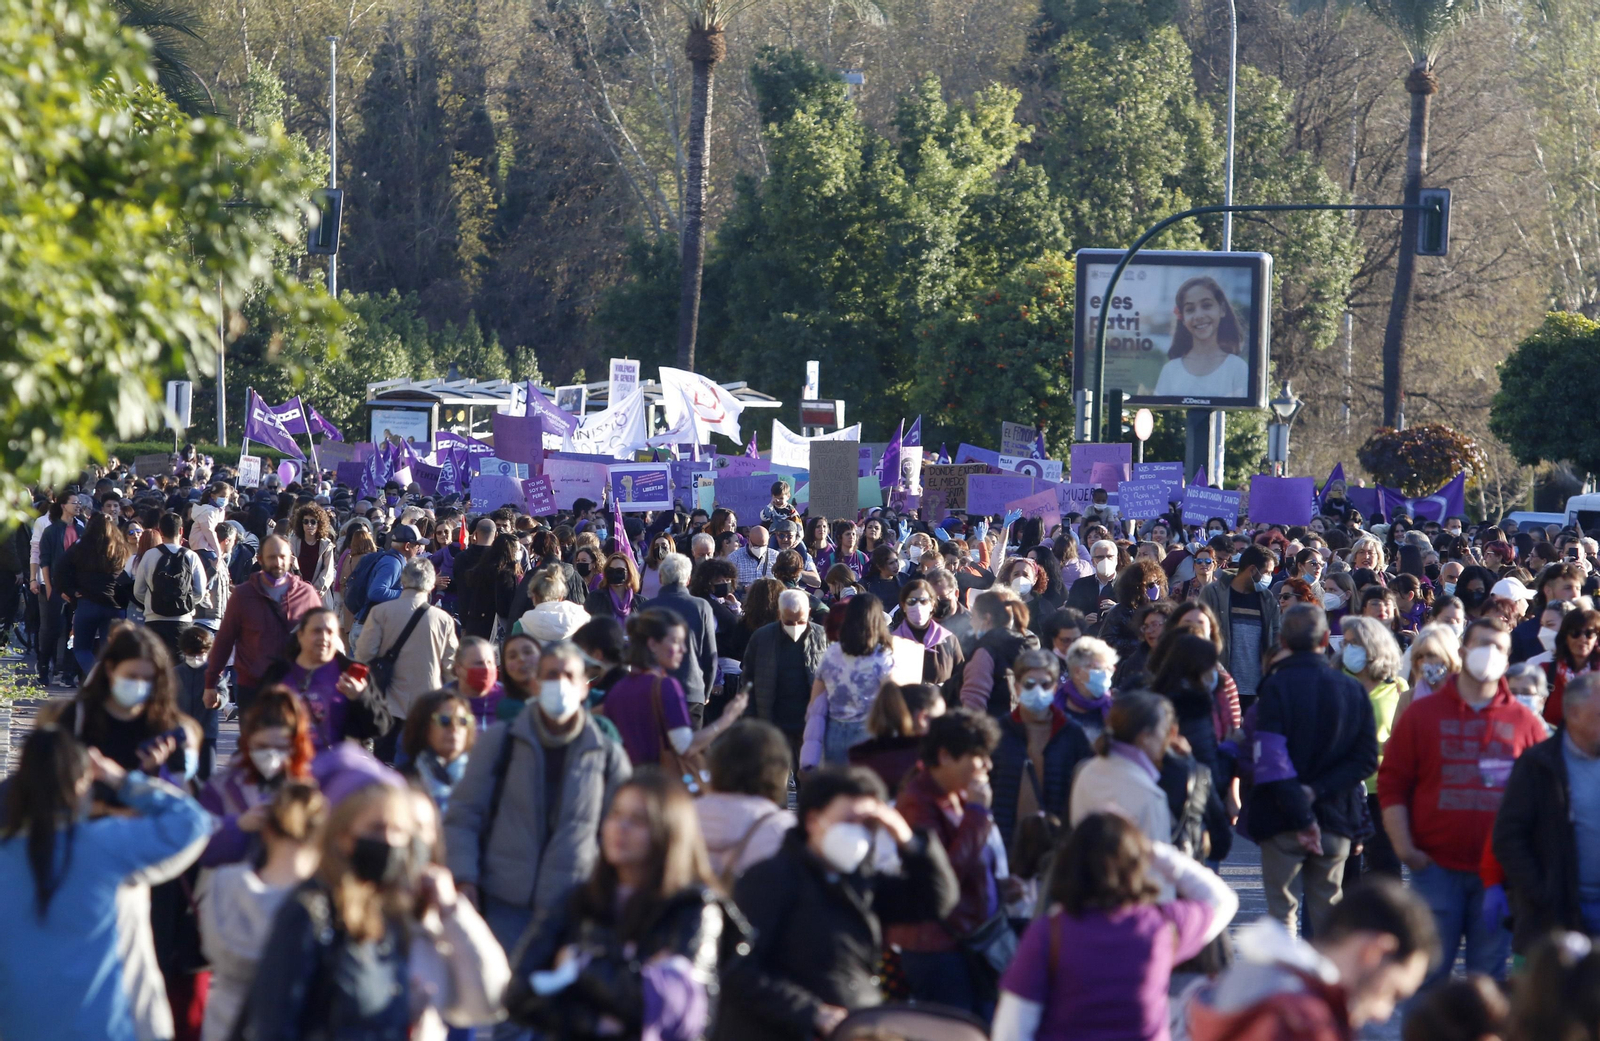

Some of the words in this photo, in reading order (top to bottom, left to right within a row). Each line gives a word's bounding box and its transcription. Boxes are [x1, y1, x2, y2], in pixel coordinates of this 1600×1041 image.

[1090, 296, 1134, 310] ees
[816, 455, 850, 470] TODAS
[929, 466, 955, 476] DONDE
[527, 481, 536, 489] YO
[928, 477, 937, 487] EL
[940, 477, 965, 486] MIEDO
[972, 478, 984, 490] NO
[991, 480, 1025, 490] ESTAMOS
[529, 487, 539, 495] SOY
[642, 485, 664, 493] LIBERTAD
[813, 481, 841, 495] SOBRE
[1186, 488, 1199, 498] NOS
[1199, 490, 1223, 502] QUITARON
[1223, 495, 1240, 505] TANTO
[471, 497, 489, 508] SER
